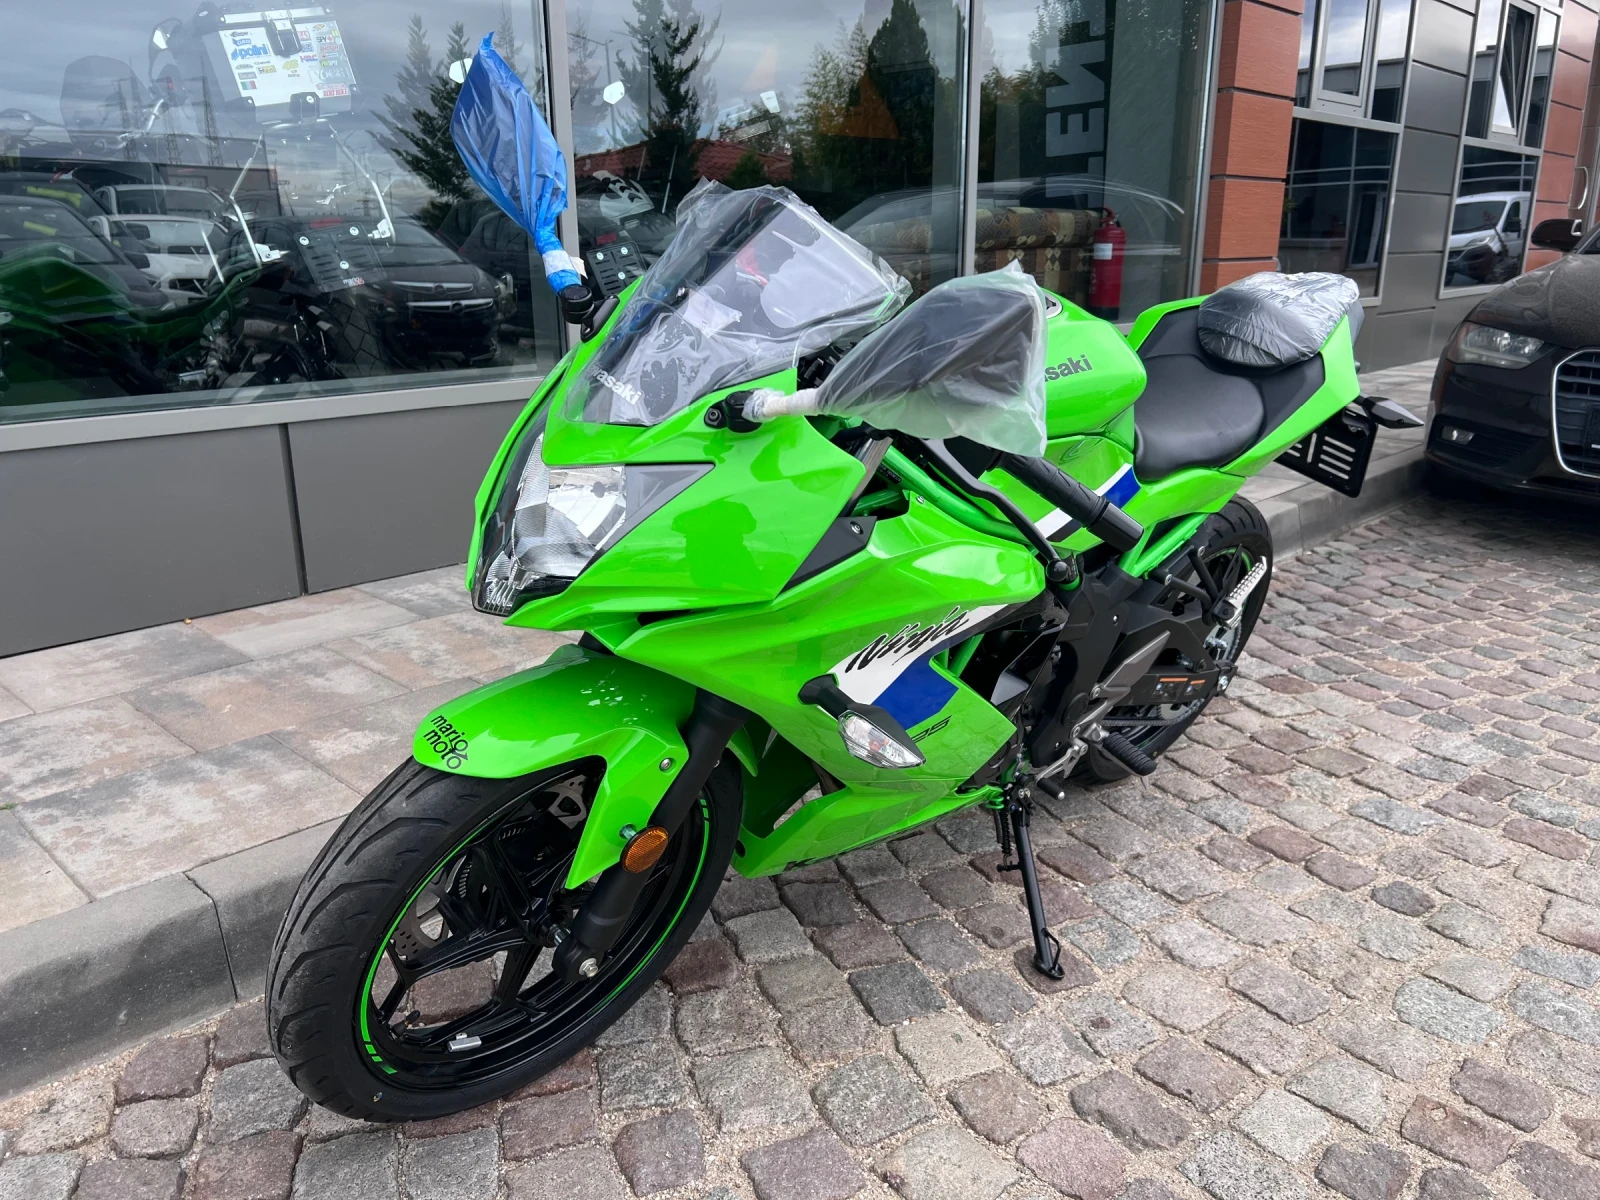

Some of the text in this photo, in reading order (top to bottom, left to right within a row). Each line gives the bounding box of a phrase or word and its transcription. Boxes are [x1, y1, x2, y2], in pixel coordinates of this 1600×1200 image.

[238, 43, 269, 59] polini
[1044, 354, 1093, 382] saki
[844, 606, 970, 674] Ninja
[422, 729, 463, 770] moto
[430, 714, 469, 752] mario
